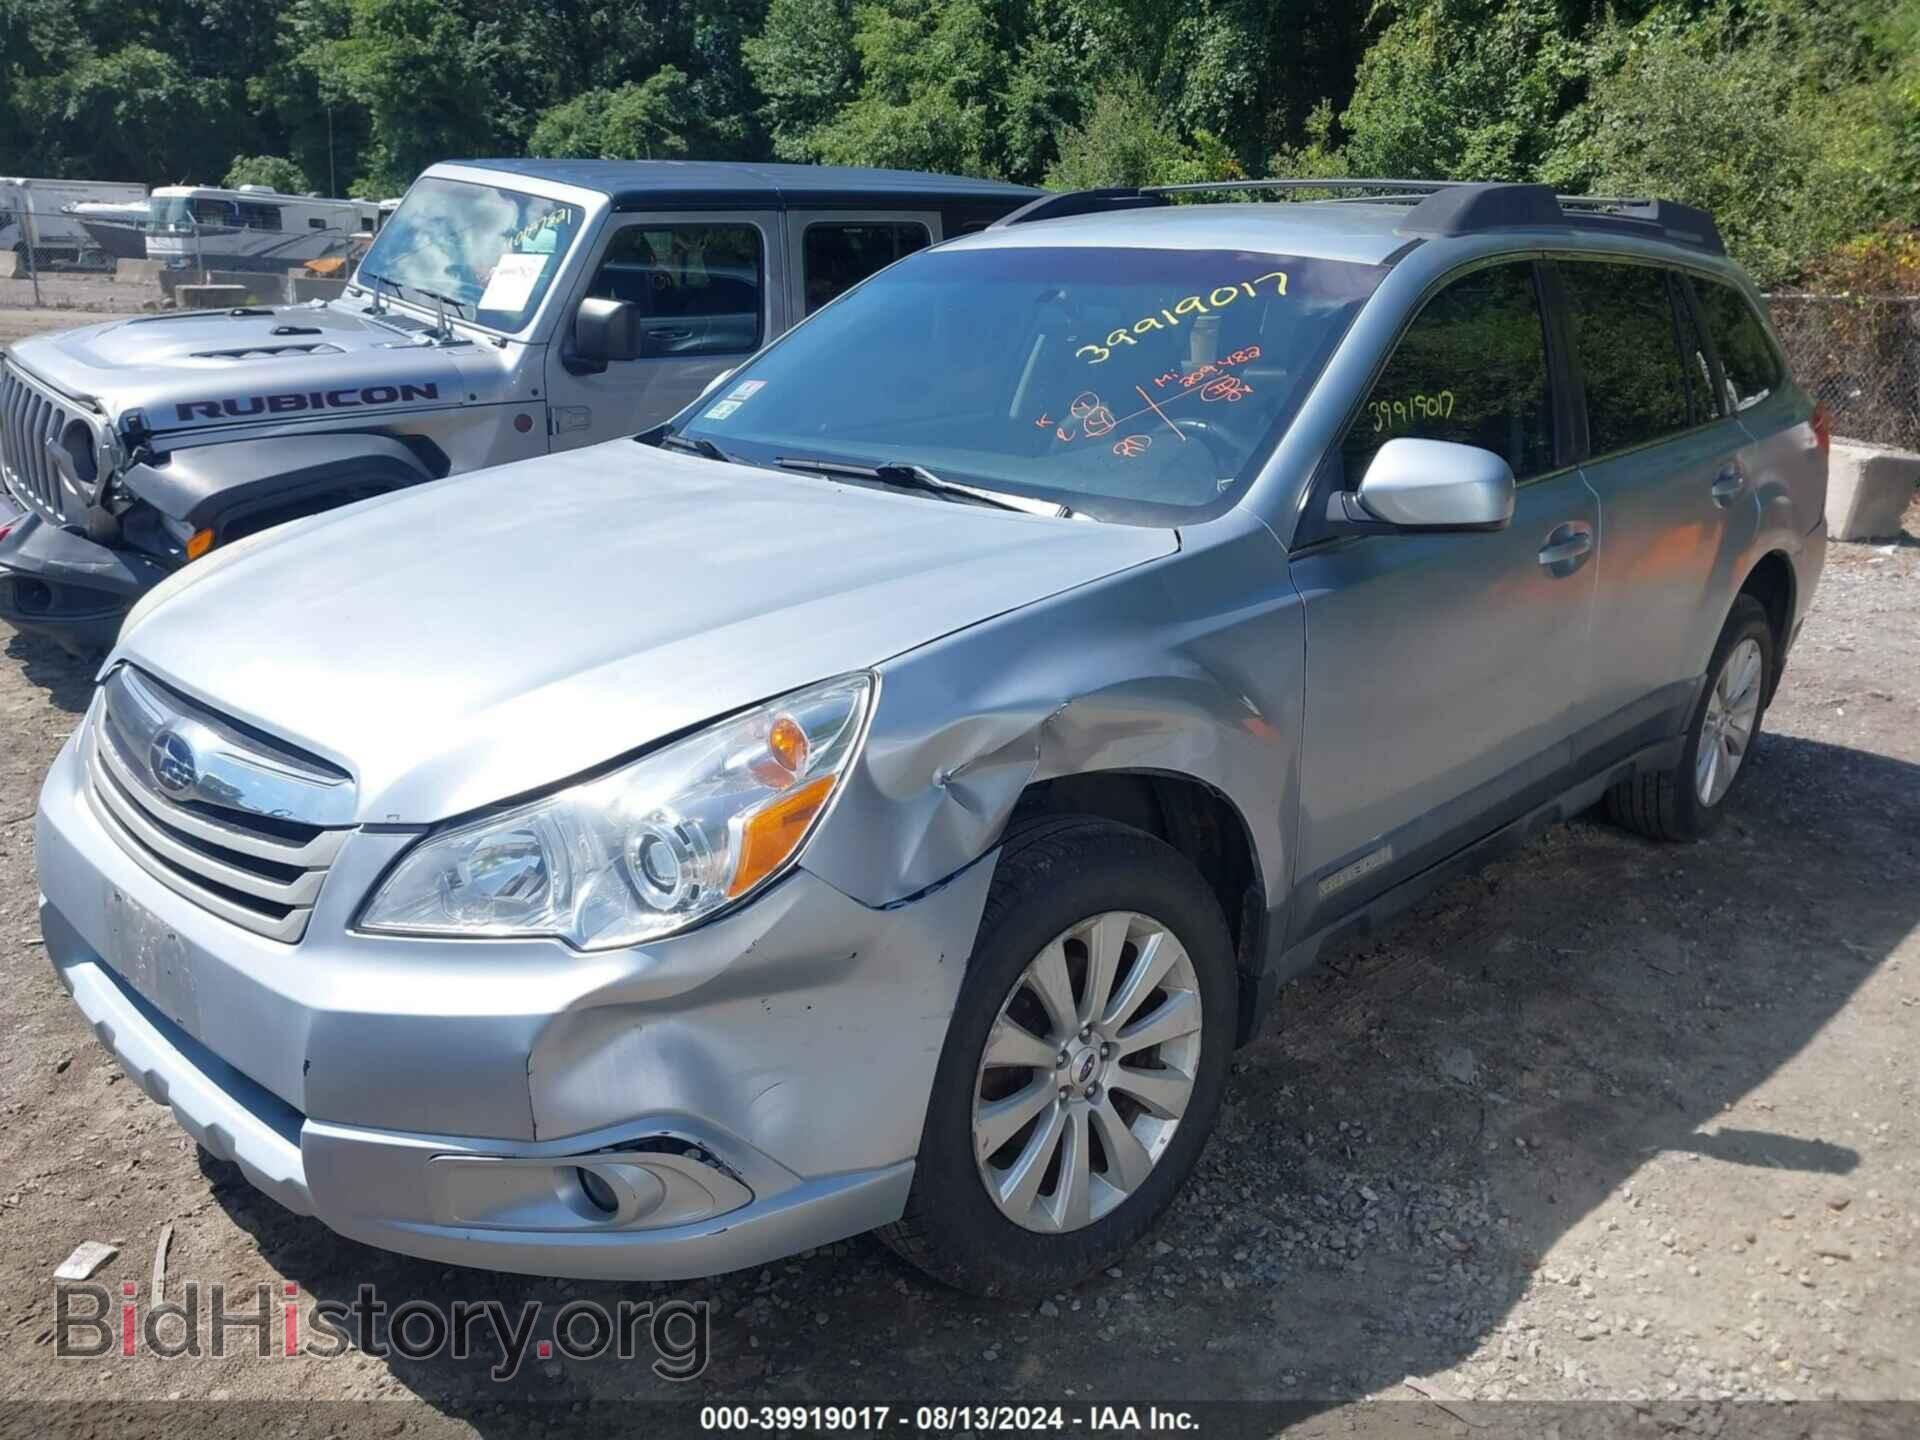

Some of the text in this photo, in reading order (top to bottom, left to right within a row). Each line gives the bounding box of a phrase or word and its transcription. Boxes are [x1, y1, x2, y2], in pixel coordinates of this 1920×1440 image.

[1076, 272, 1288, 363] 39919017
[175, 382, 439, 421] RUBICON
[1368, 390, 1454, 432] 39919017
